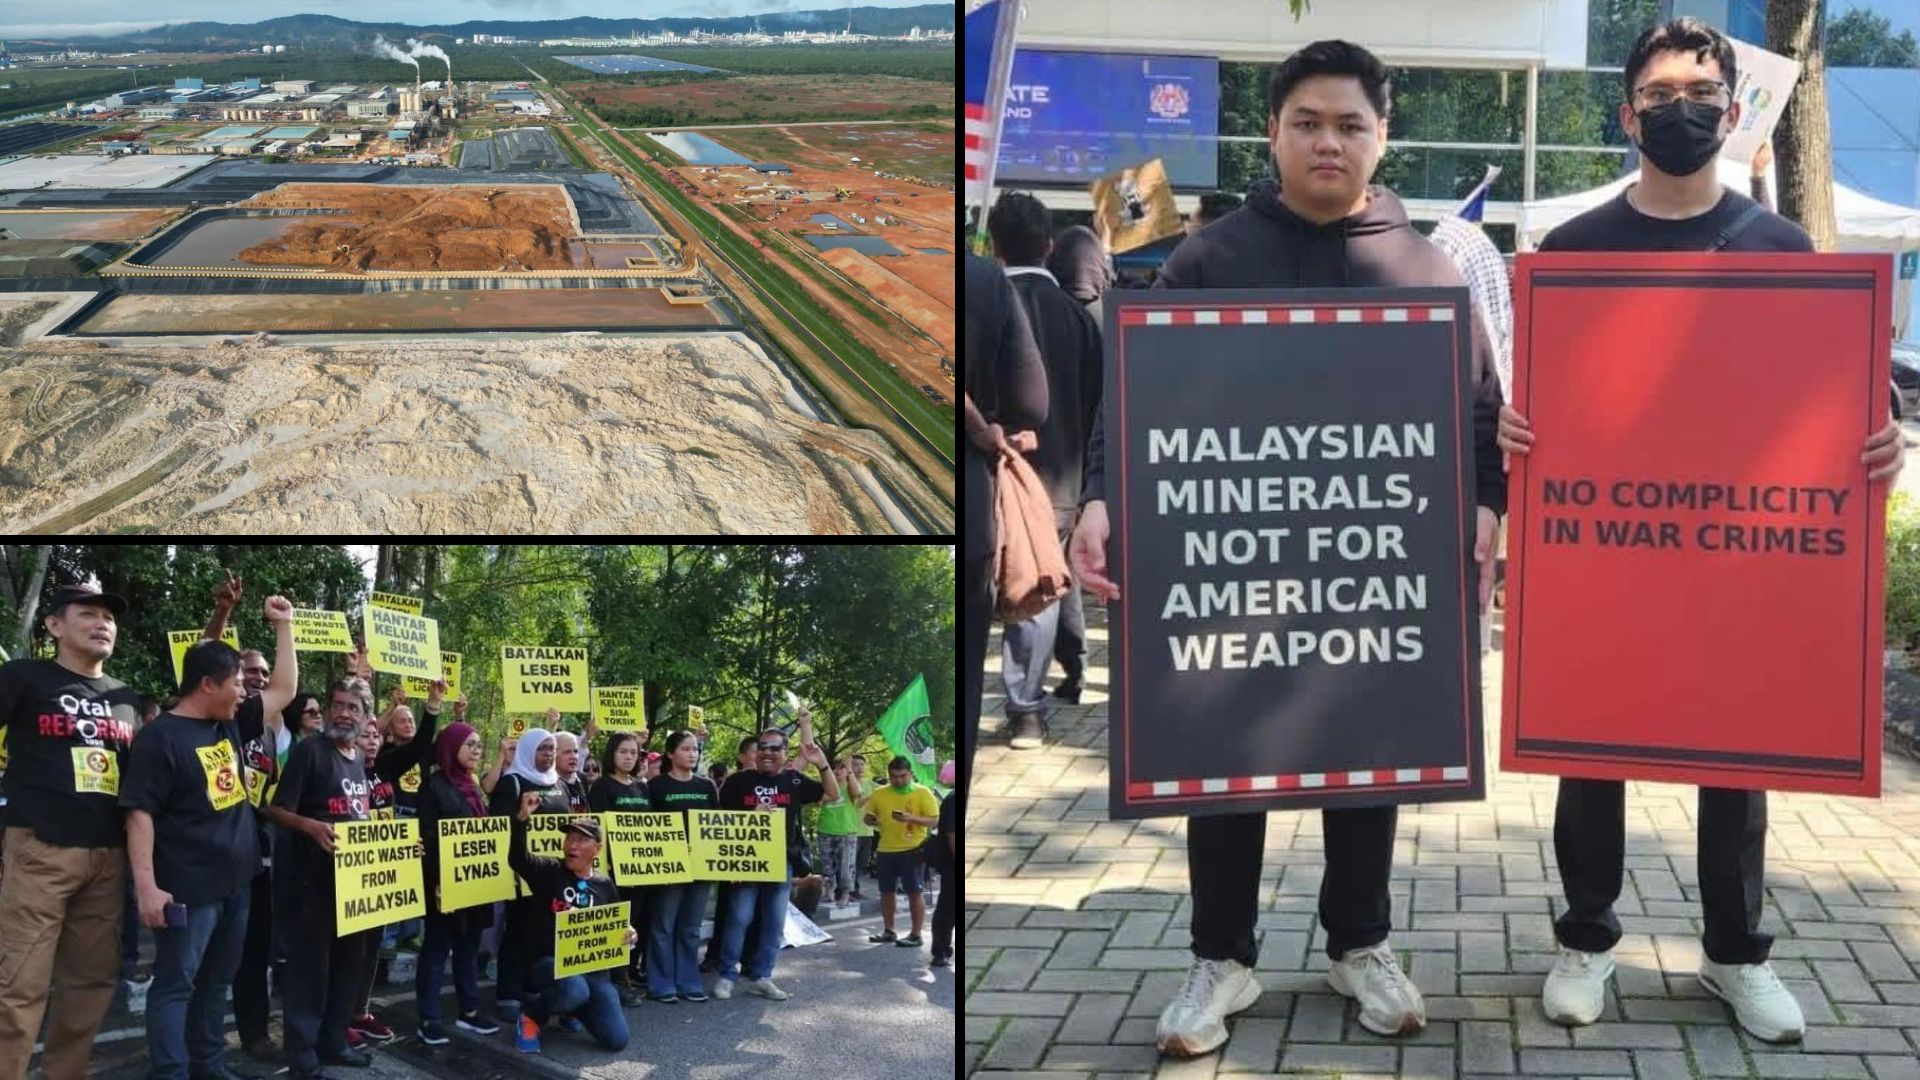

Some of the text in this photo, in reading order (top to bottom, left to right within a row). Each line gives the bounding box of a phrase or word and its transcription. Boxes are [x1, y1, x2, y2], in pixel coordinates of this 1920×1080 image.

[1148, 422, 1435, 463] MALAYSIAN
[1156, 473, 1429, 515] MINERALS,
[1543, 479, 1849, 516] NO COMPLICITY
[1185, 525, 1407, 566] NOT FOR
[1543, 518, 1846, 556] IN WAR CRIMES
[372, 593, 420, 609] BATALKAN
[1161, 575, 1428, 620] AMERICAN
[293, 610, 337, 621] EMOVE
[372, 609, 426, 631] HANTAR
[301, 628, 330, 636] FROM
[375, 623, 427, 644] KELUAR
[389, 640, 418, 655] SISA
[505, 647, 584, 660] BATALKAN
[1168, 626, 1423, 671] WEAPONS
[380, 652, 428, 670] TOKSIK
[520, 664, 570, 677] LESEN
[521, 682, 573, 694] LYNAS
[599, 690, 635, 699] HANTAR
[60, 695, 112, 717] Otai
[600, 699, 636, 708] KELUAR
[604, 717, 636, 725] TOKSIK
[610, 709, 629, 717] SISA
[441, 817, 508, 836] BATALKAN
[615, 814, 672, 827] REMOVE
[698, 813, 771, 827] HANTAR
[347, 823, 409, 844] REMOVE
[608, 830, 685, 842] TOXIC WASTE
[700, 828, 772, 841] KELUAR
[336, 845, 420, 868] TOXIC WASTE
[453, 839, 497, 858] LESEN
[631, 847, 664, 858] FROM
[718, 845, 756, 857] SISA
[454, 862, 500, 882] LYNAS
[619, 861, 686, 876] MALAYSIA
[706, 860, 770, 873] TOKSIK
[361, 869, 397, 889] FROM
[345, 888, 418, 919] MALAYSIA
[568, 906, 620, 925] REMOVE
[557, 920, 629, 940] TOXIC WASTE
[577, 936, 608, 950] FROM
[562, 947, 624, 968] MALAYSIA
